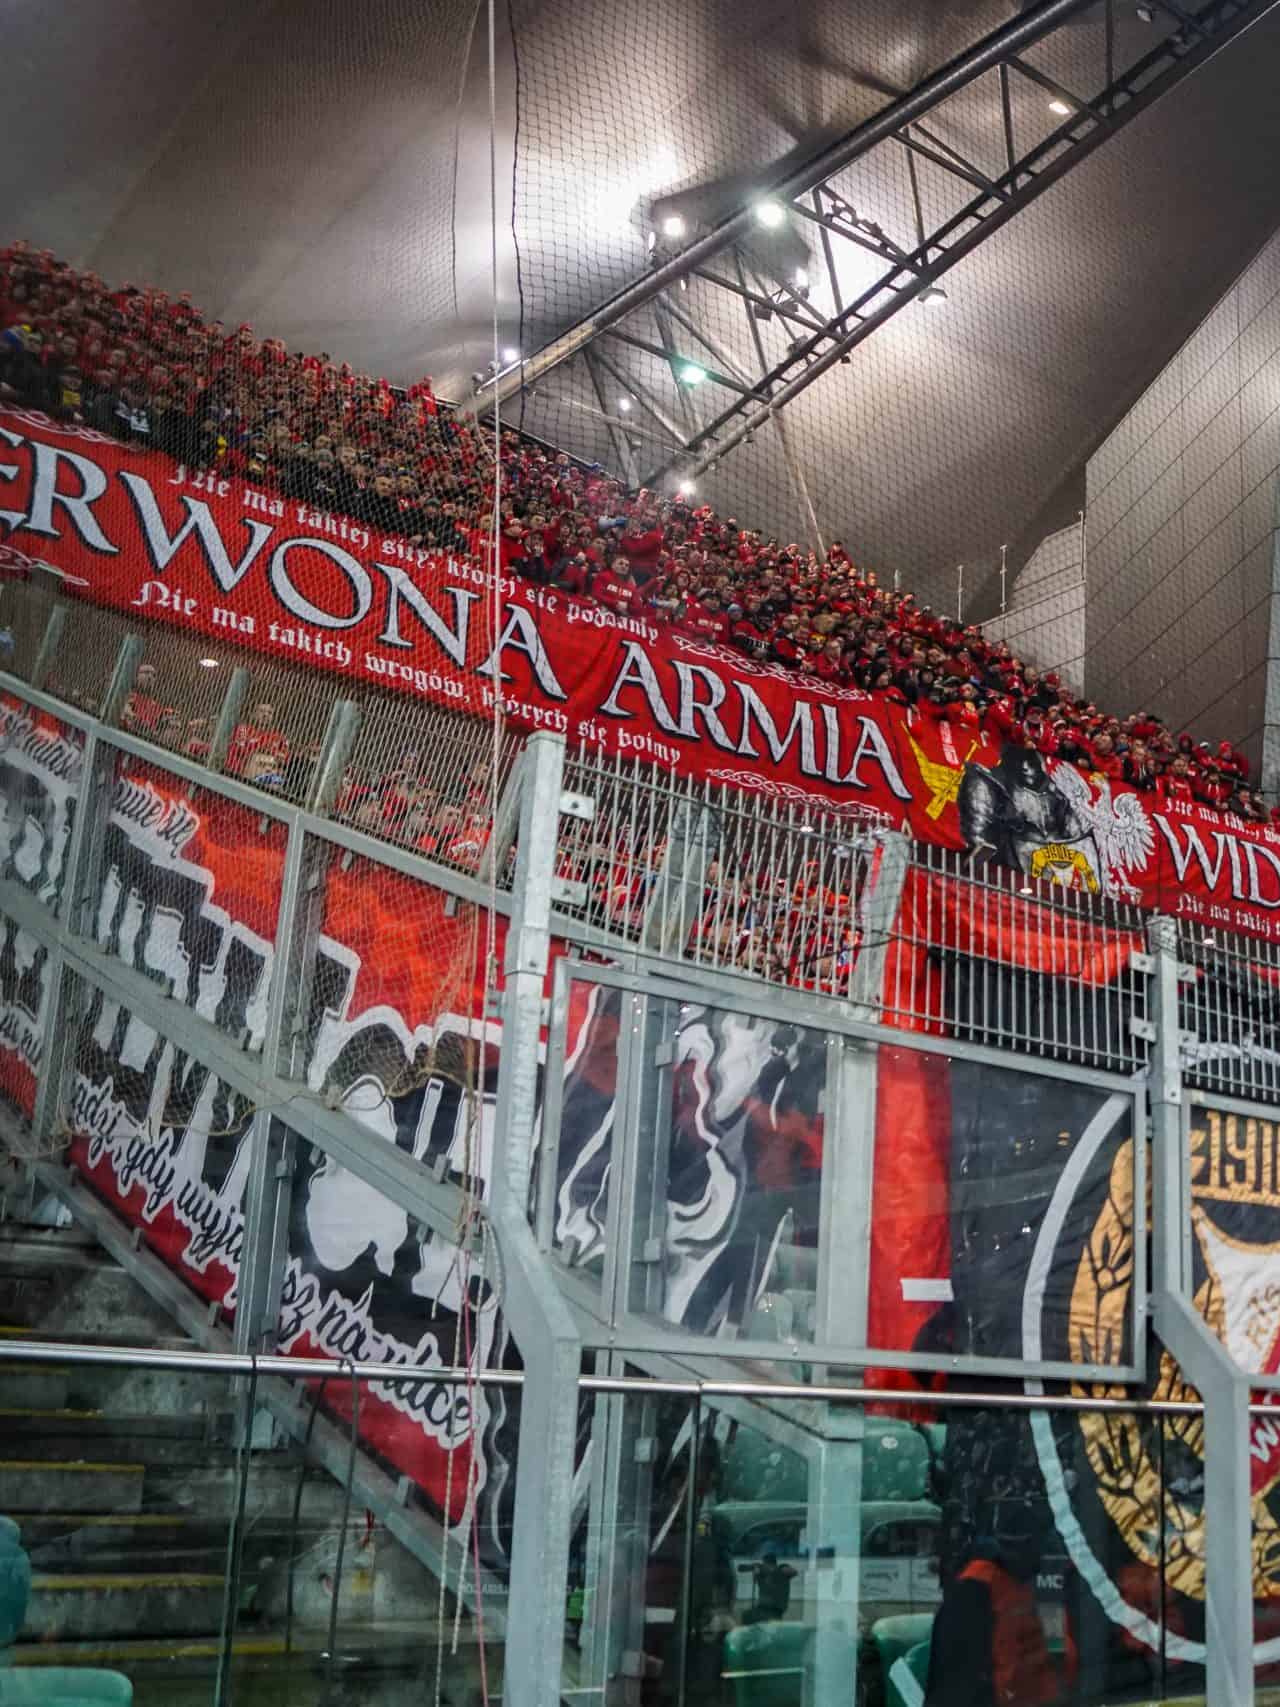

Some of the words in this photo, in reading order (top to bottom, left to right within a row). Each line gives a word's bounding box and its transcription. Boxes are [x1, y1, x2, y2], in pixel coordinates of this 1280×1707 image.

[243, 489, 284, 517] ma
[131, 580, 197, 615] Nie
[213, 607, 255, 633] ma
[268, 621, 351, 666] takich
[601, 640, 912, 799] ARMIA
